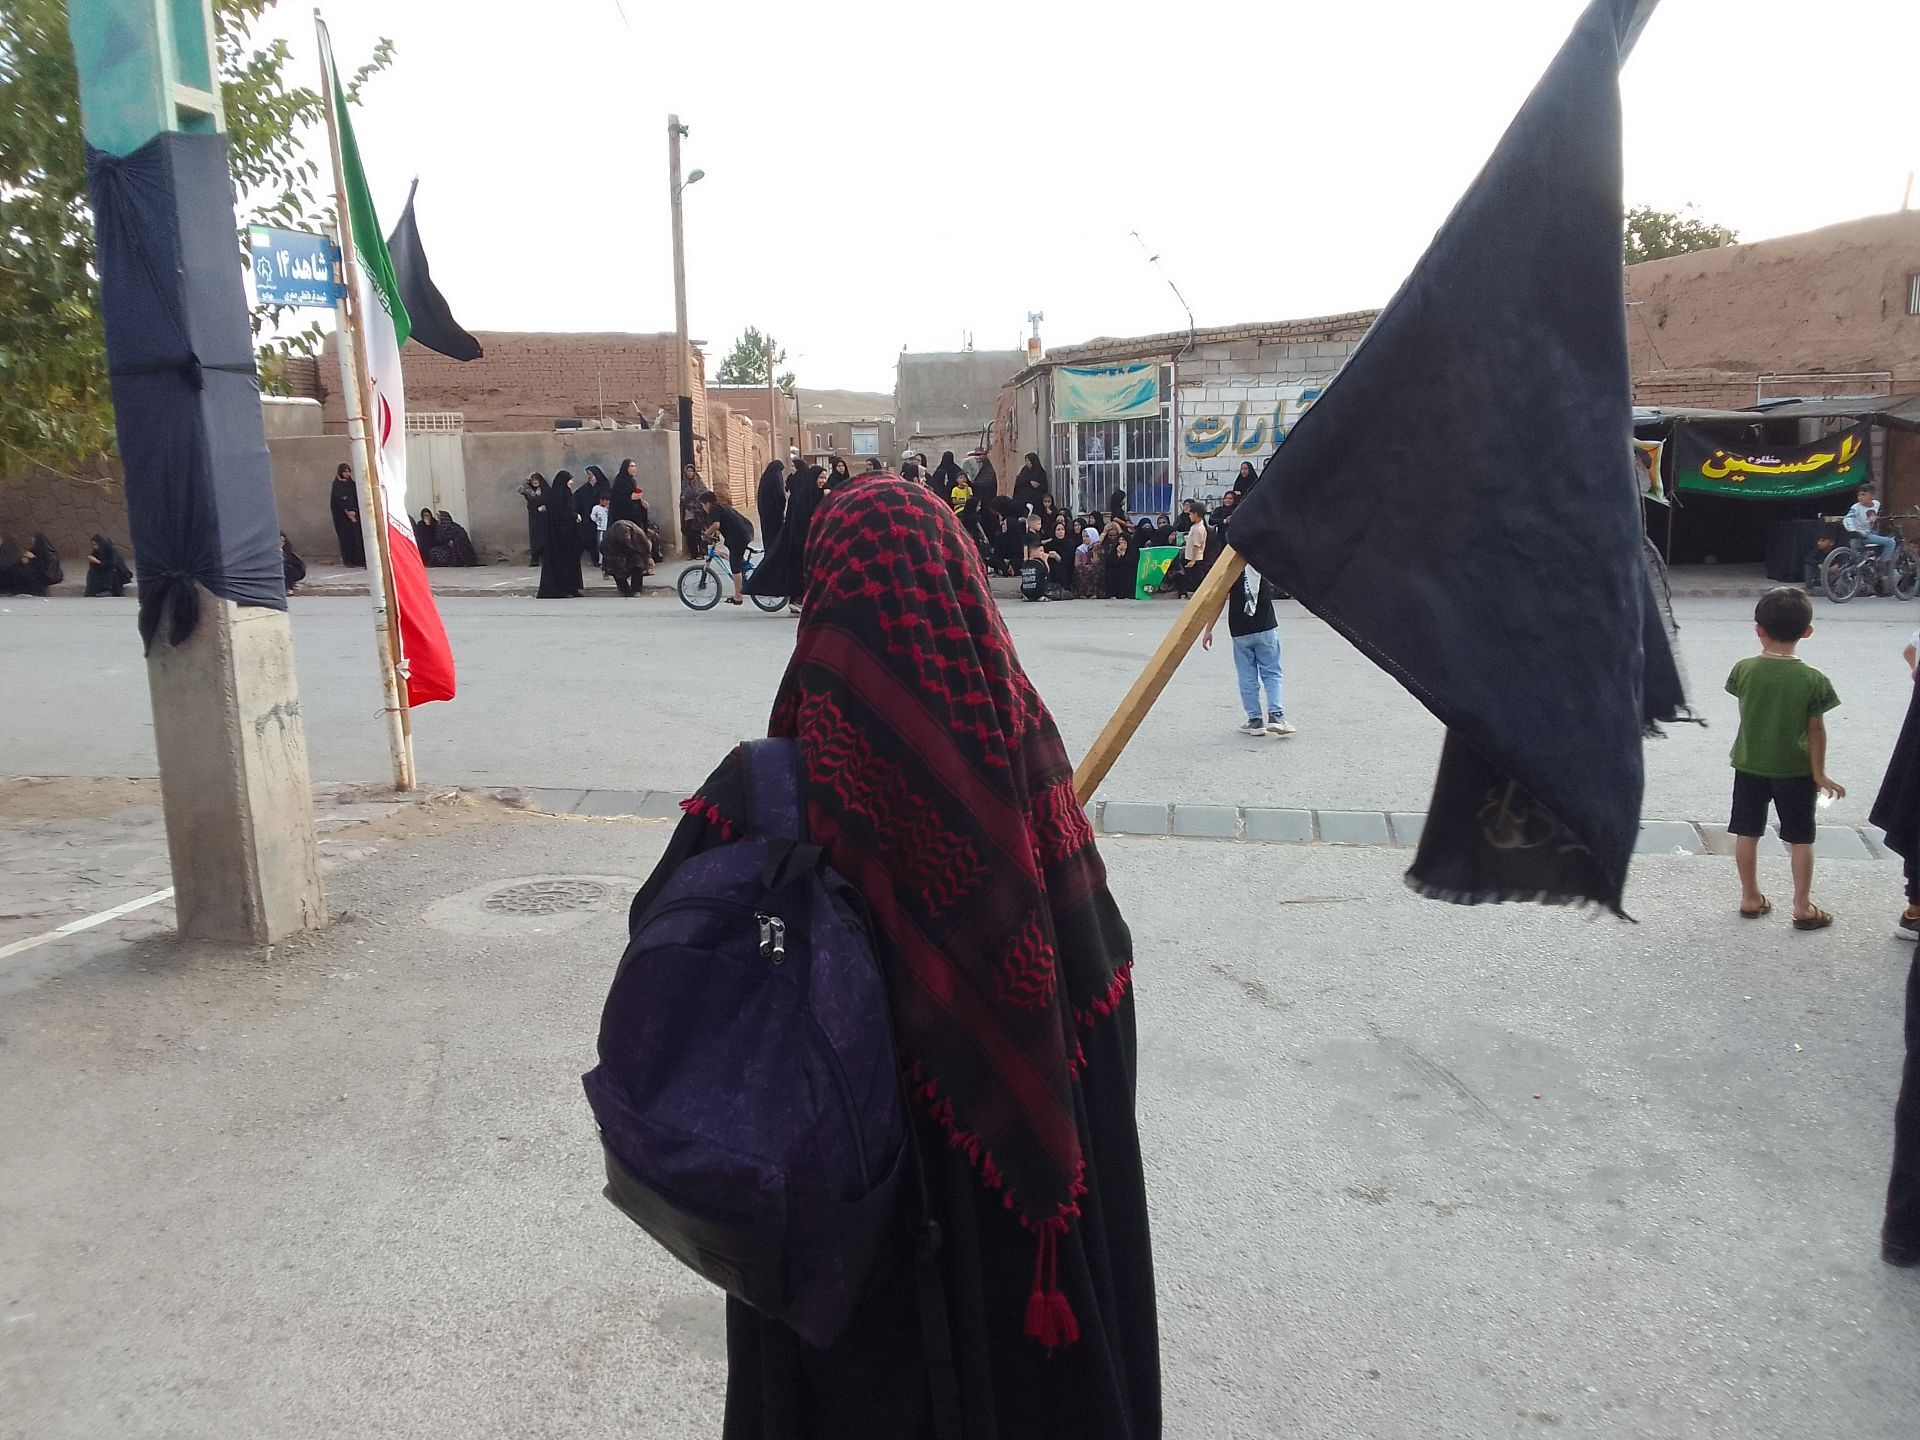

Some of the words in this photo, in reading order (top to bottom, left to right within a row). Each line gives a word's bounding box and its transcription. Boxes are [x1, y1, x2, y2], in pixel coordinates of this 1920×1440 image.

[276, 249, 290, 278] ۱۴
[292, 251, 328, 282] شاهد
[1702, 450, 1836, 482] حسین
[1747, 455, 1782, 465] مظلوم
[1838, 434, 1862, 473] یا
